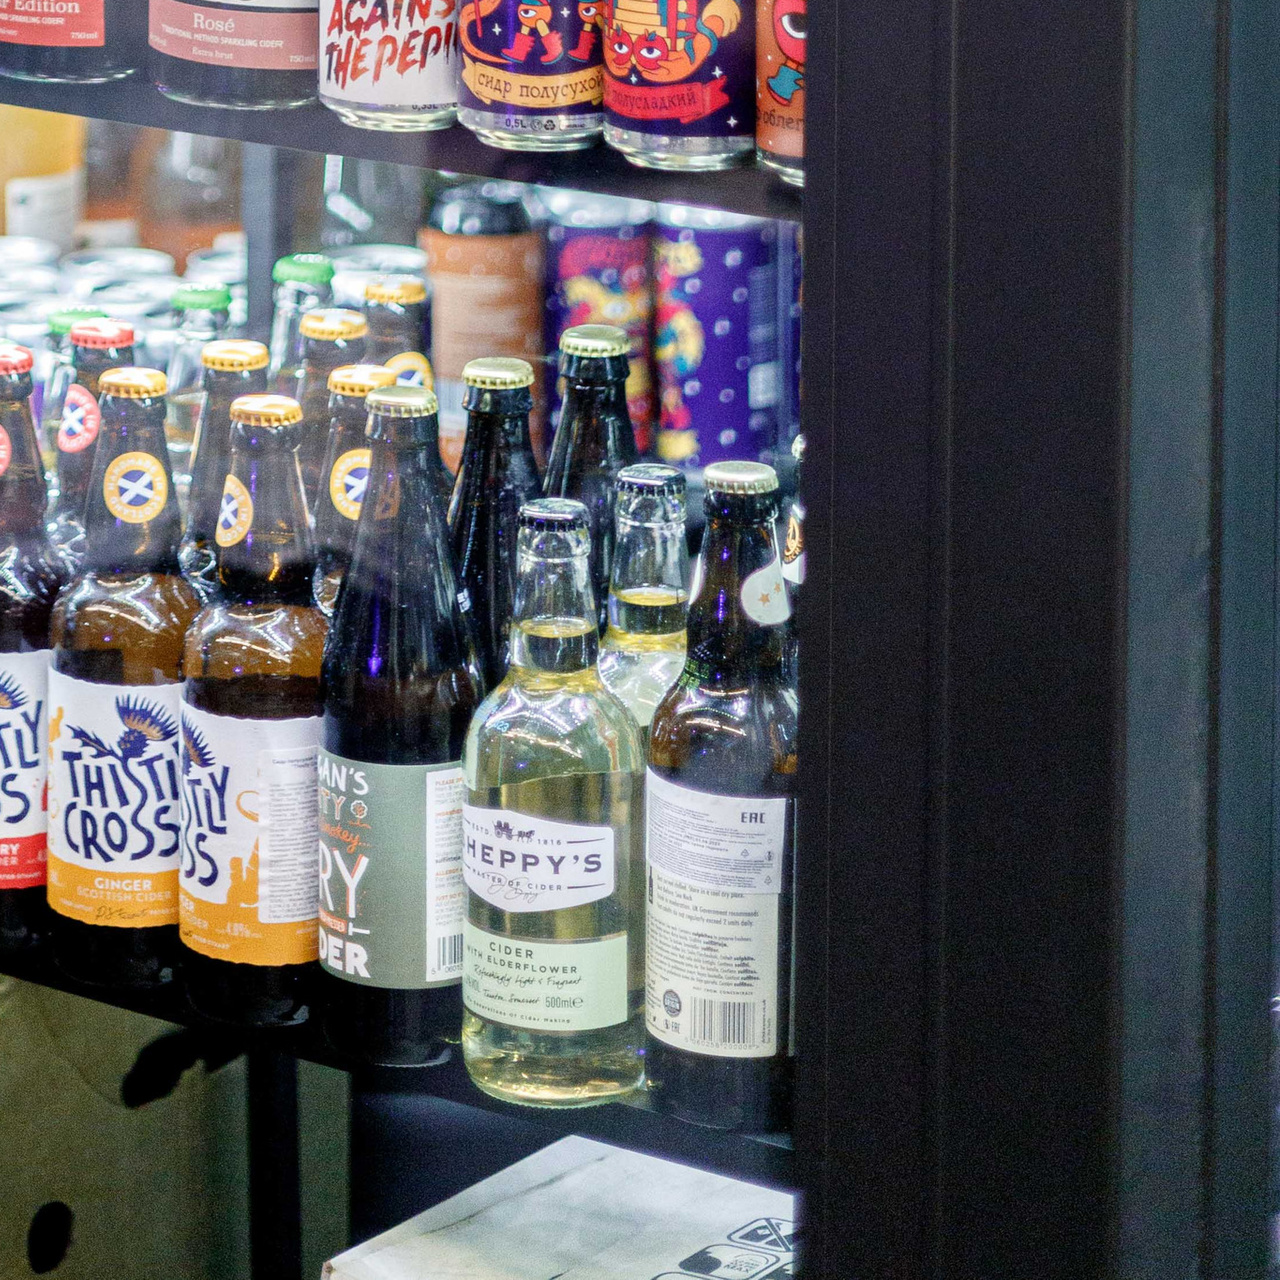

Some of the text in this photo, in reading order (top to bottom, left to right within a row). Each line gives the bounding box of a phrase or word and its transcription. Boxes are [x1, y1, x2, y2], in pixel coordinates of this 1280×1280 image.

[193, 12, 236, 33] Rosé
[325, 33, 373, 91] THE
[477, 71, 513, 102] сидр
[505, 117, 527, 130] 0,5L
[63, 801, 180, 863] CROSS
[536, 837, 563, 846] 1816
[466, 835, 604, 876] HEPPY'S
[94, 876, 153, 892] GINGER
[472, 867, 503, 886] MASTER
[527, 882, 564, 892] CIDER
[76, 886, 173, 904] SCOTTISH CIDER
[721, 890, 730, 899] dry
[699, 906, 728, 917] Government
[727, 918, 740, 926] units
[489, 941, 535, 960] CIDER
[486, 955, 579, 975] ELDERFLOWER
[514, 974, 535, 989] Light
[546, 976, 583, 989] Fragrant
[519, 1014, 540, 1022] Cider
[543, 1017, 571, 1025] Making
